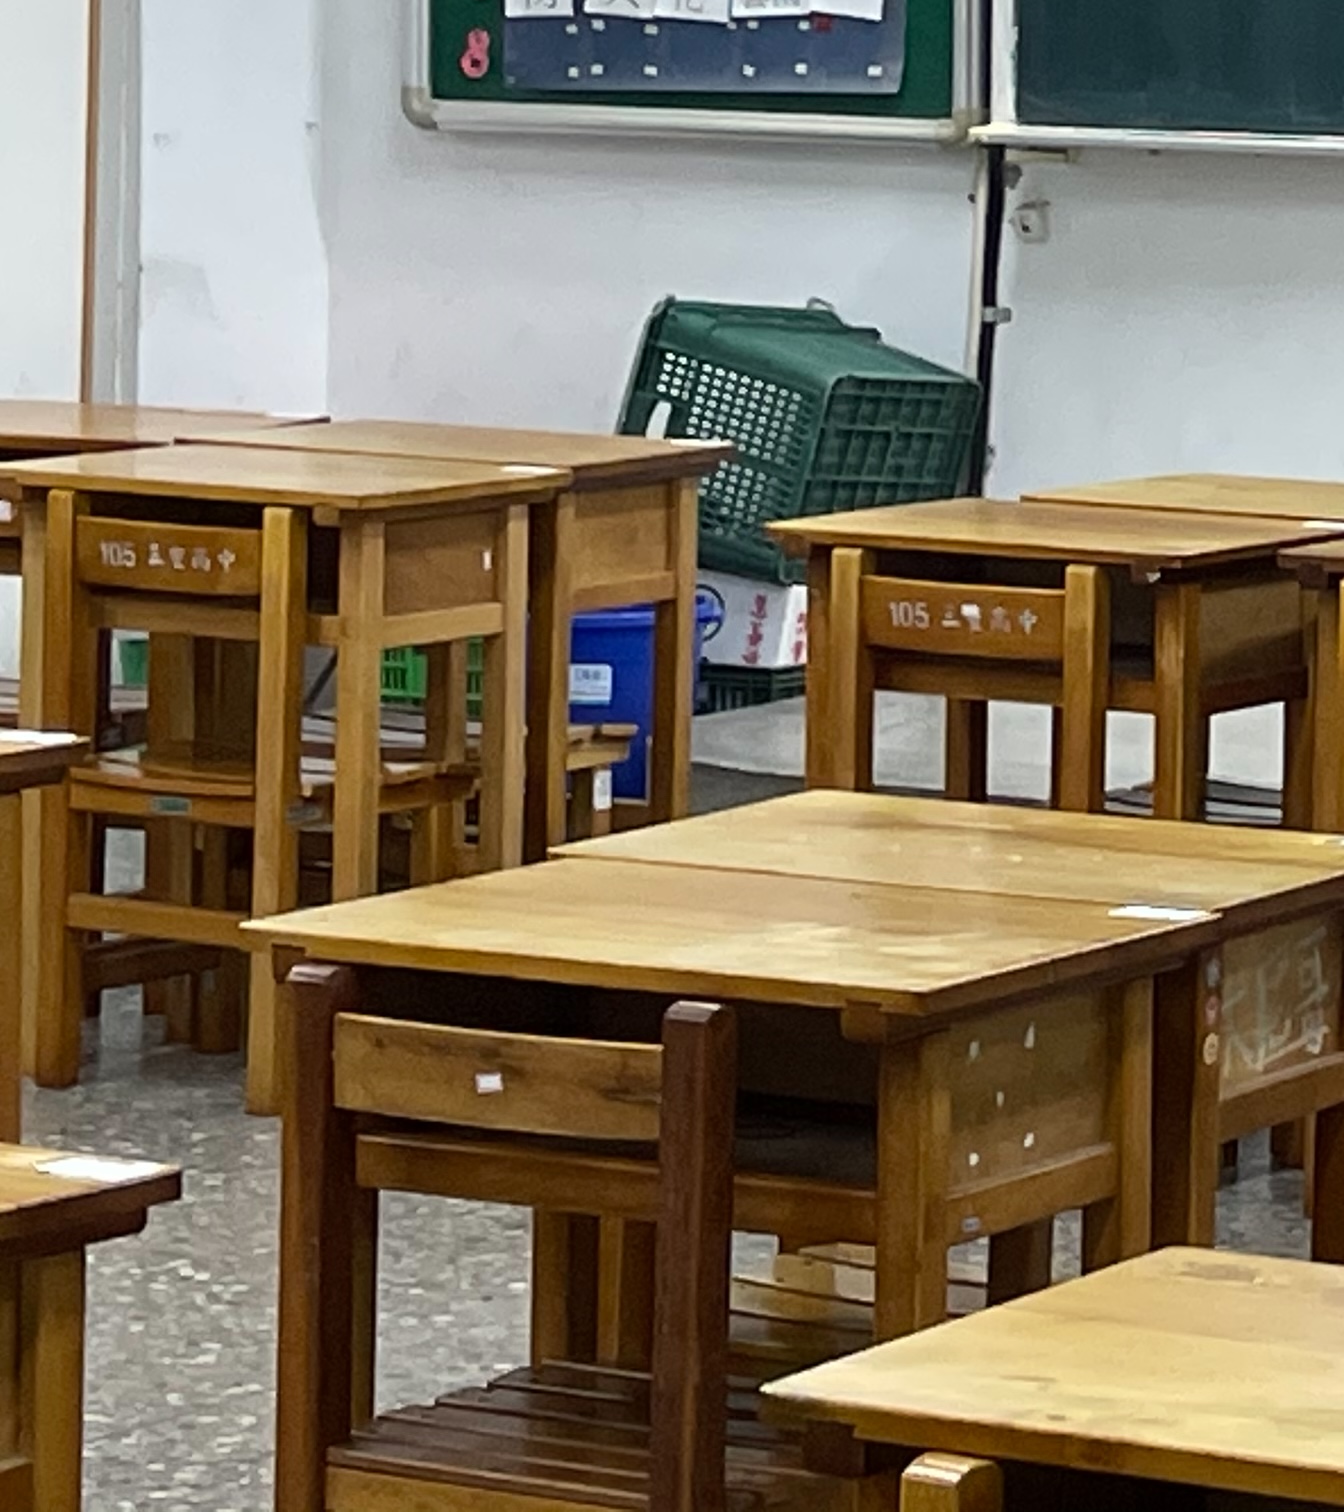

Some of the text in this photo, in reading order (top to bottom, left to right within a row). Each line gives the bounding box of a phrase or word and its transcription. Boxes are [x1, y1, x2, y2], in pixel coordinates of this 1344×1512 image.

[460, 28, 490, 79] 8
[100, 541, 137, 568] 105
[889, 601, 930, 630] 105
